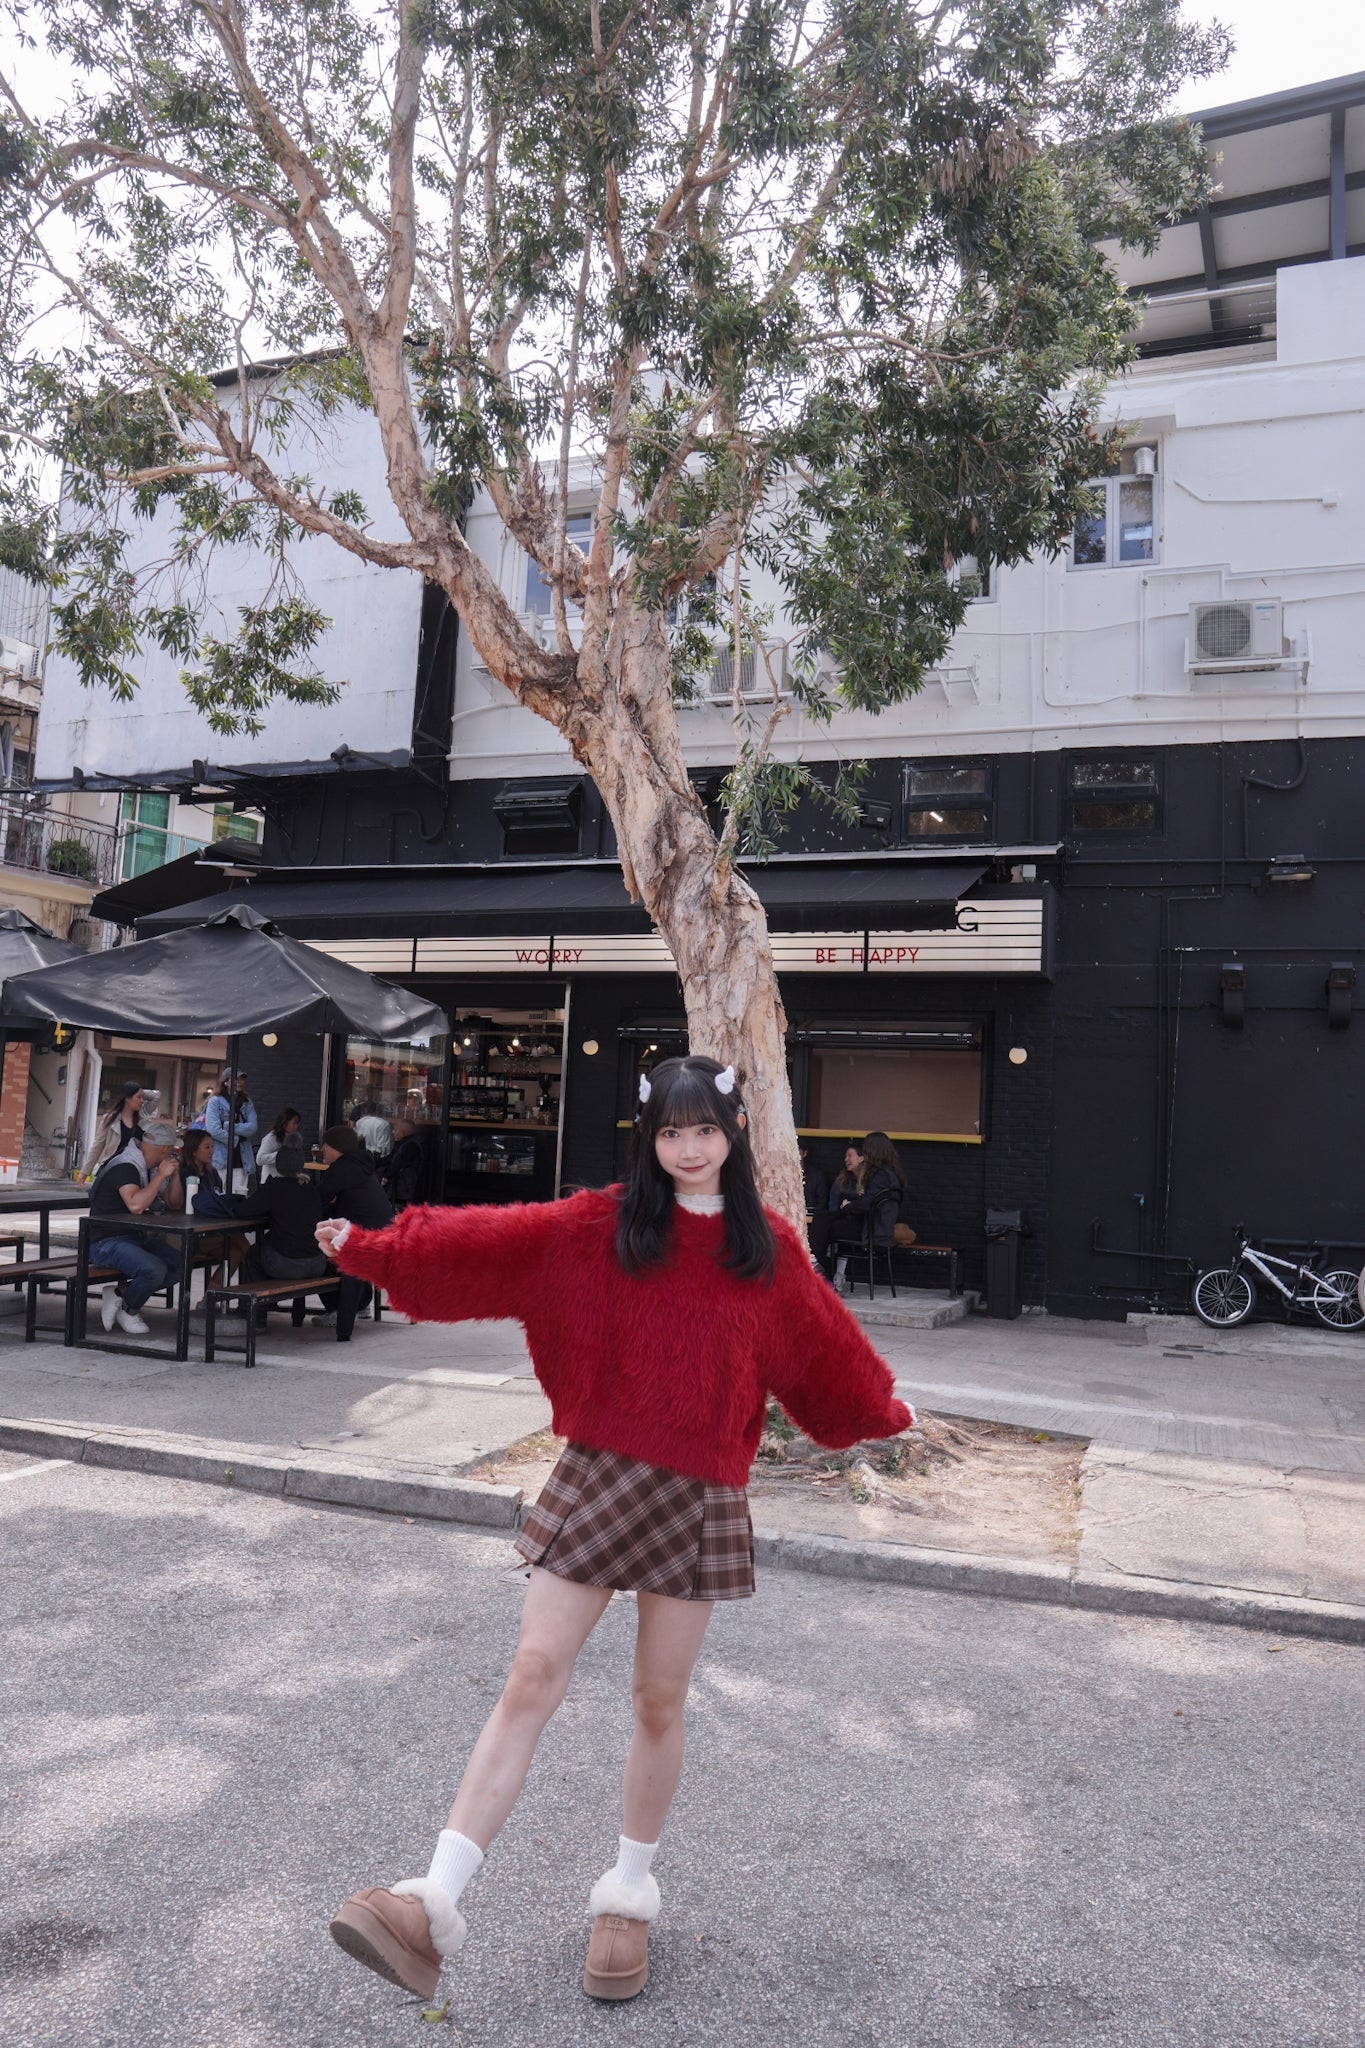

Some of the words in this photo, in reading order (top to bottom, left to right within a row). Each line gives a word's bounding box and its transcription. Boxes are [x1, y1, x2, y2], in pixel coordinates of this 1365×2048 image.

[515, 949, 583, 964] WORRY
[815, 948, 837, 963] BE
[851, 947, 920, 964] HAPPY
